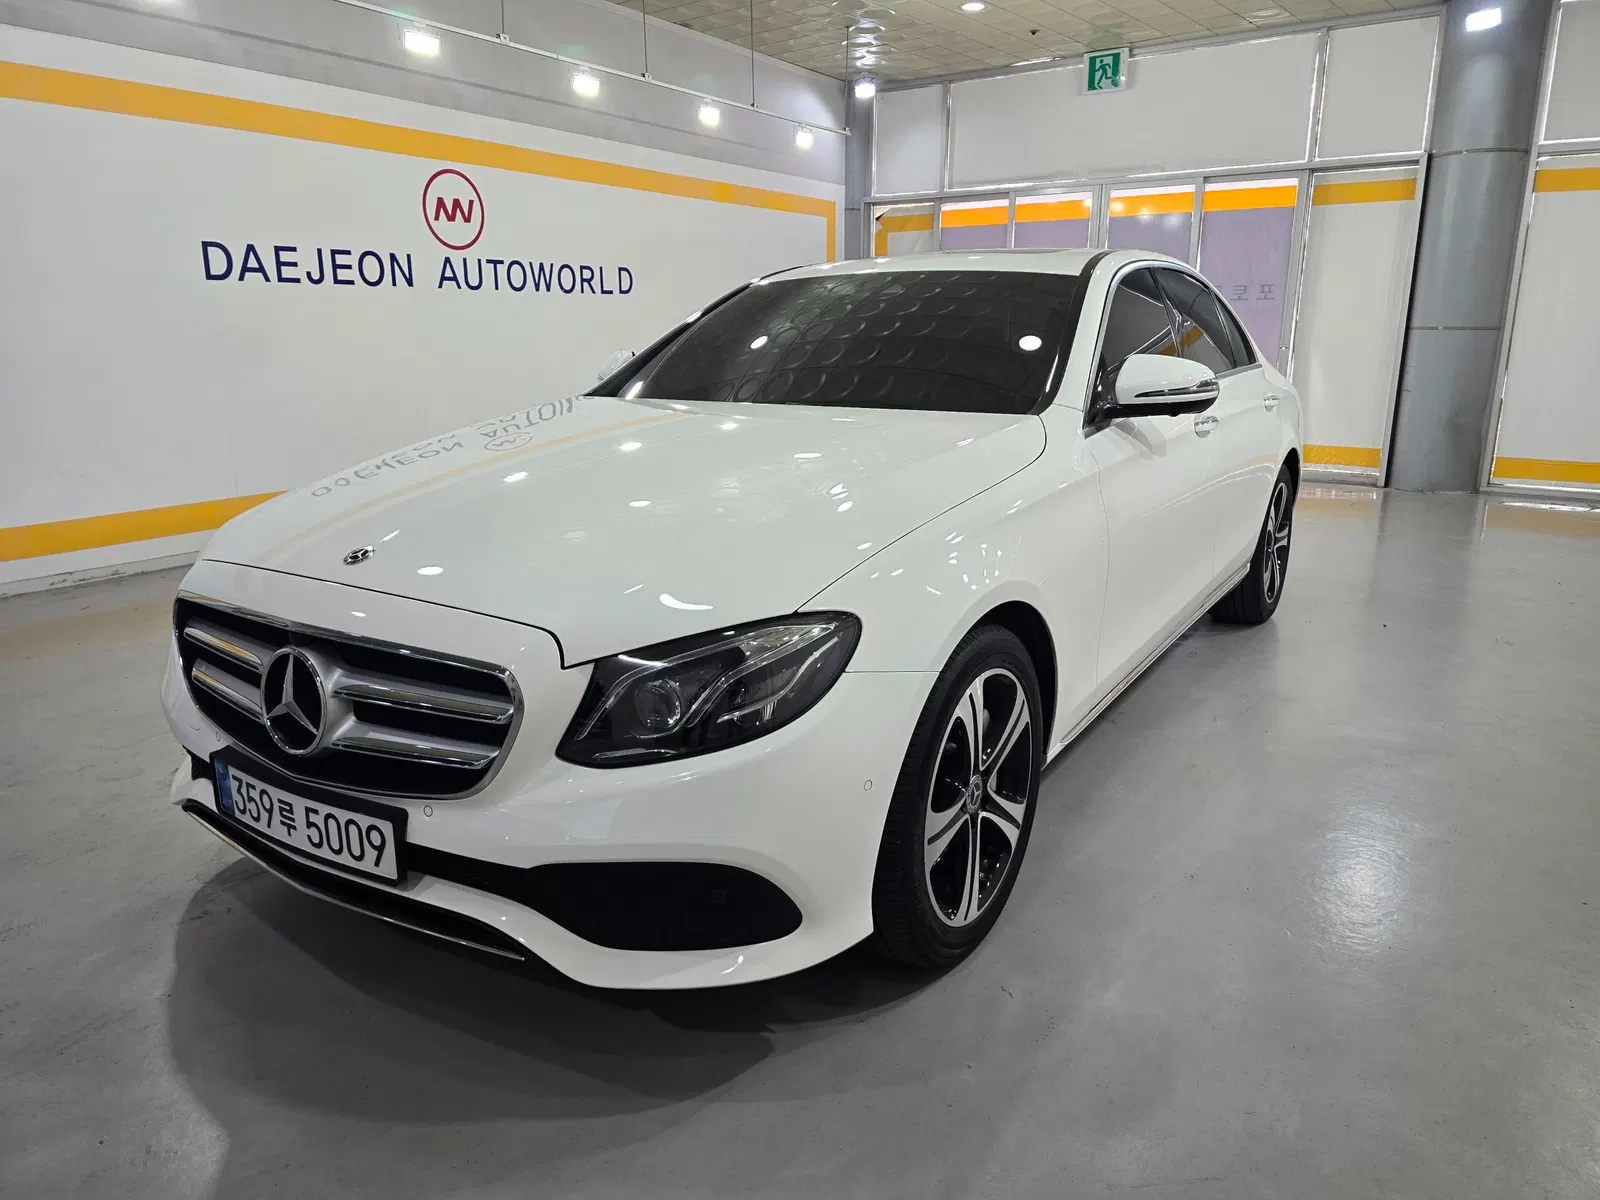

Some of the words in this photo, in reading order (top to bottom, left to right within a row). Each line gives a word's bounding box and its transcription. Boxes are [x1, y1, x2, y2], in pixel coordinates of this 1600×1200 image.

[201, 240, 414, 288] DAEJEON
[438, 256, 634, 295] AUTOWORLD
[304, 806, 386, 867] 5009
